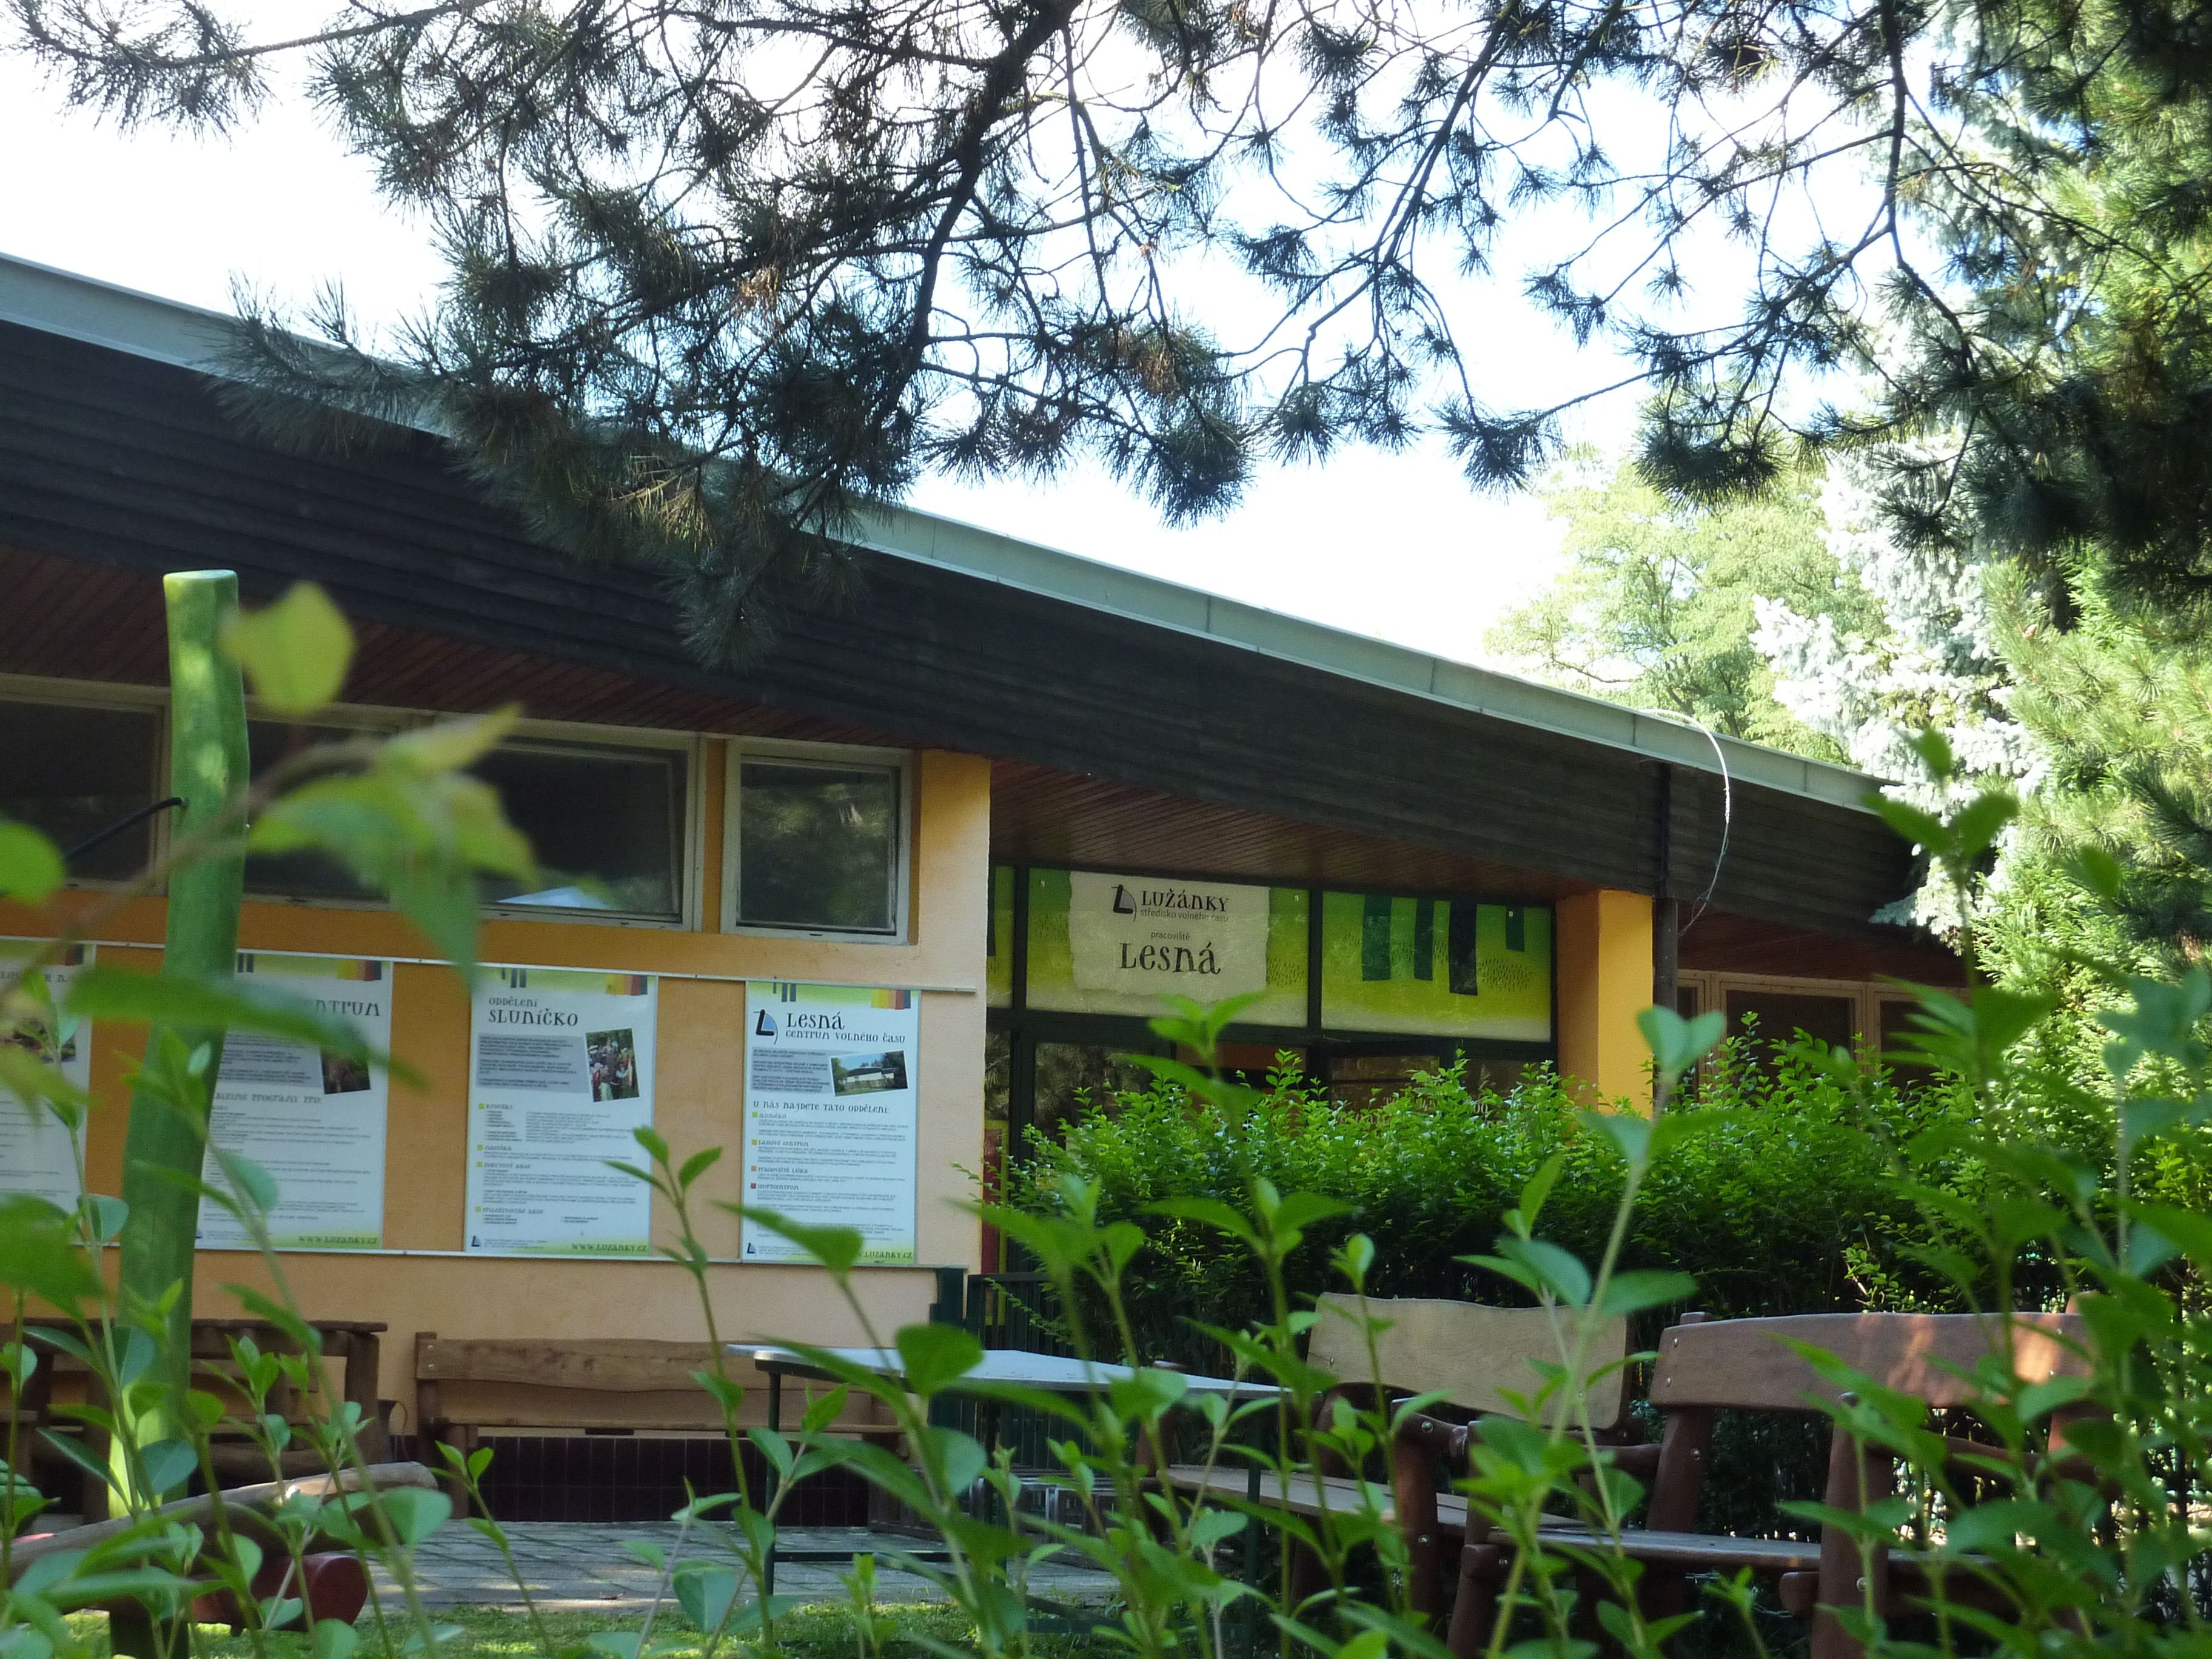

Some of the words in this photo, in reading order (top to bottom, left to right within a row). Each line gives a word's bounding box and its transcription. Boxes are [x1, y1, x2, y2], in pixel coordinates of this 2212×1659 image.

[1140, 909, 1176, 919] středisko
[1151, 931, 1190, 940] pracoviště
[1118, 942, 1221, 974] Lesná
[488, 1008, 578, 1027] SLUNÍČKO
[786, 1011, 845, 1030] Lesná
[786, 1030, 830, 1040] CENTRUM
[836, 1031, 879, 1042] VOLNÉHO
[882, 1033, 906, 1044] ČASU
[763, 1100, 779, 1109] NÁS
[783, 1102, 819, 1111] NAJDETE
